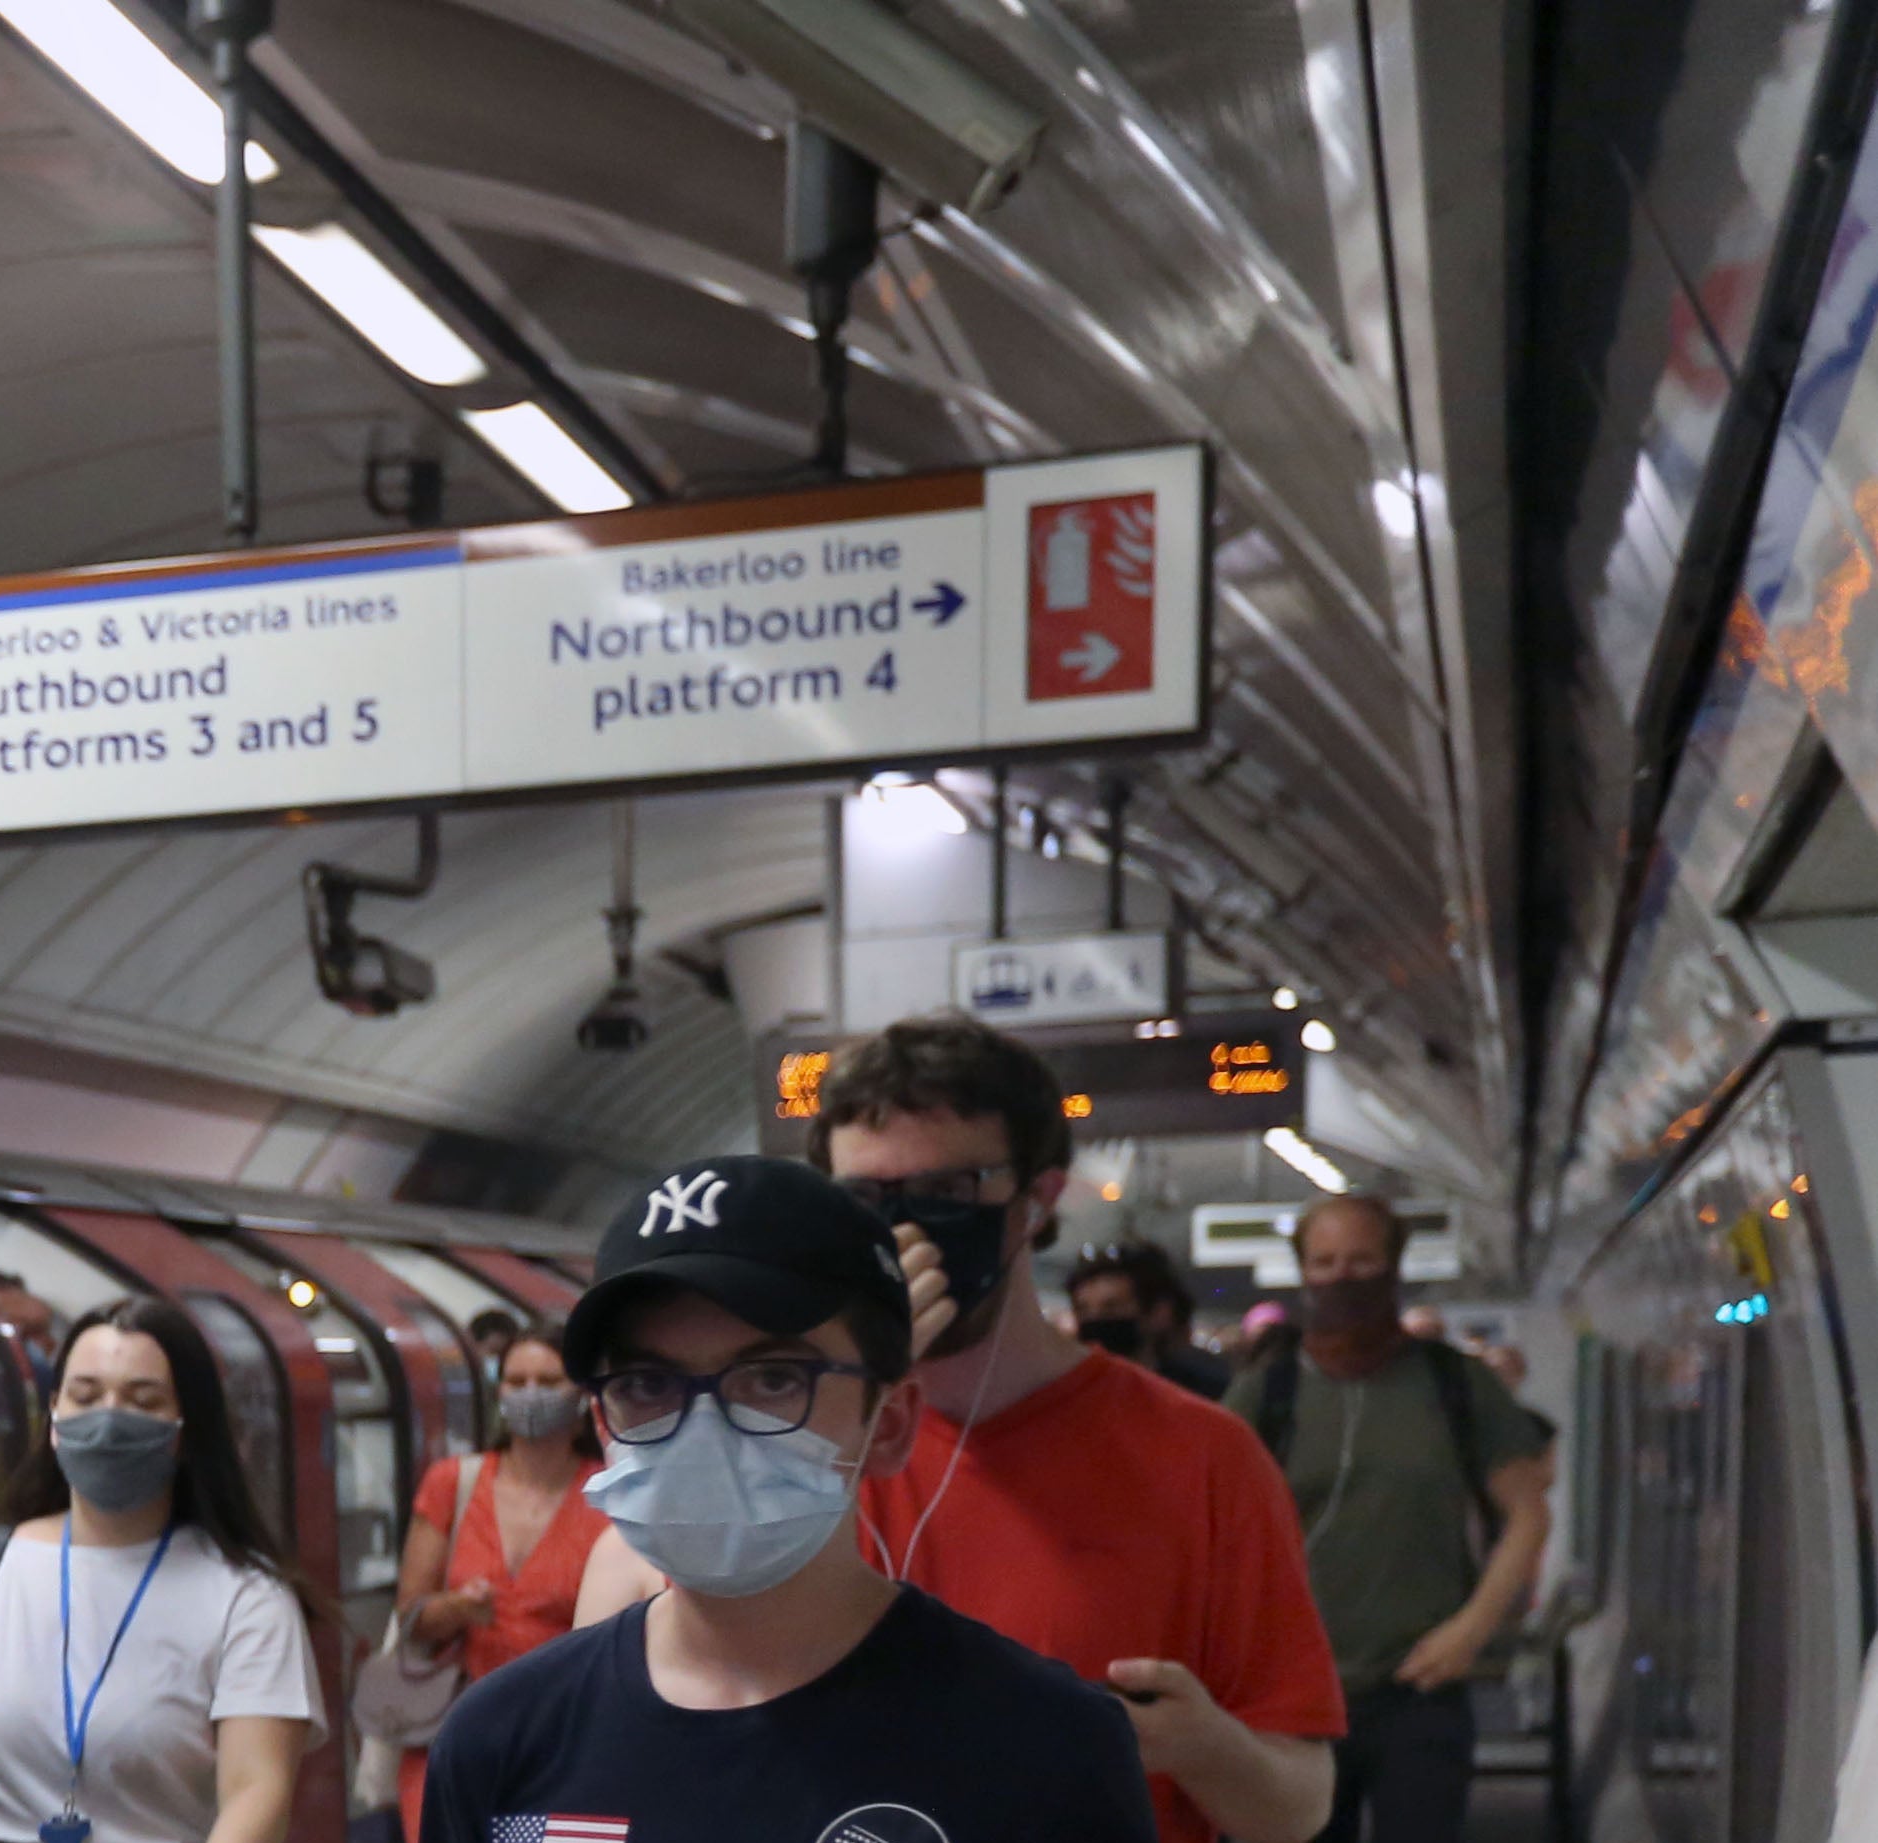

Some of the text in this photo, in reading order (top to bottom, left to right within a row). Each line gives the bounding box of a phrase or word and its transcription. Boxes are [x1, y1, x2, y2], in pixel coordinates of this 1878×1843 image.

[621, 539, 901, 595] Bakerloo line
[97, 617, 121, 648] &
[140, 600, 290, 643] Victoria
[305, 593, 399, 627] lines
[550, 584, 901, 663] Northbound
[593, 648, 898, 734] platform 4
[188, 713, 217, 757] 3
[237, 704, 330, 752] and
[351, 699, 380, 743] 5
[638, 1170, 729, 1237] NY
